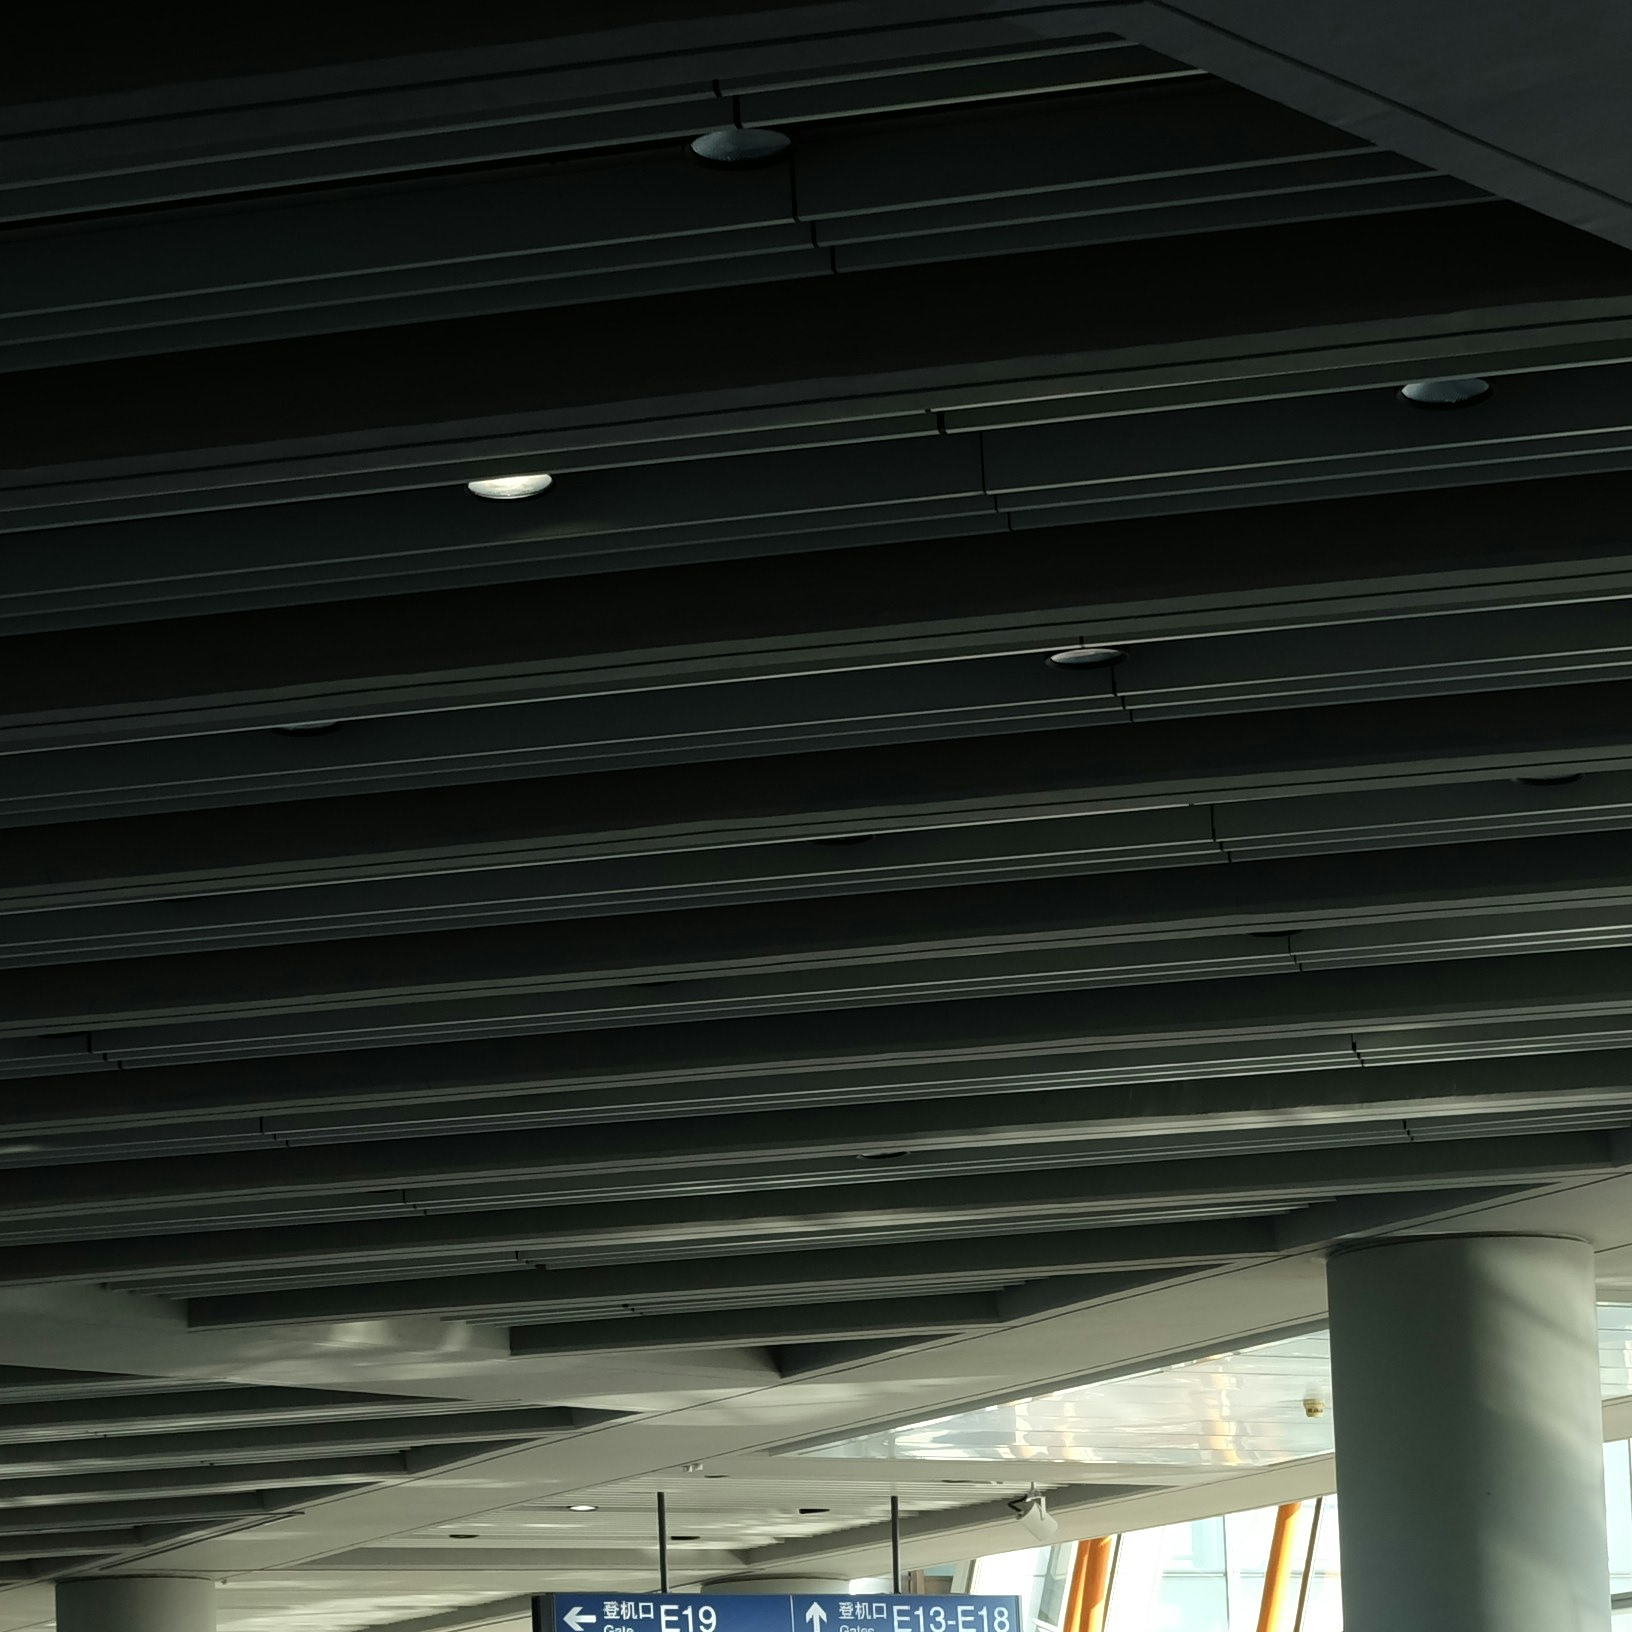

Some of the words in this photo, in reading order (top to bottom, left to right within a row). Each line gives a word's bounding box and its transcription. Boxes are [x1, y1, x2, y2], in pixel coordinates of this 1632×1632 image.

[602, 1601, 654, 1620] 登机口
[838, 1602, 887, 1620] 登机口
